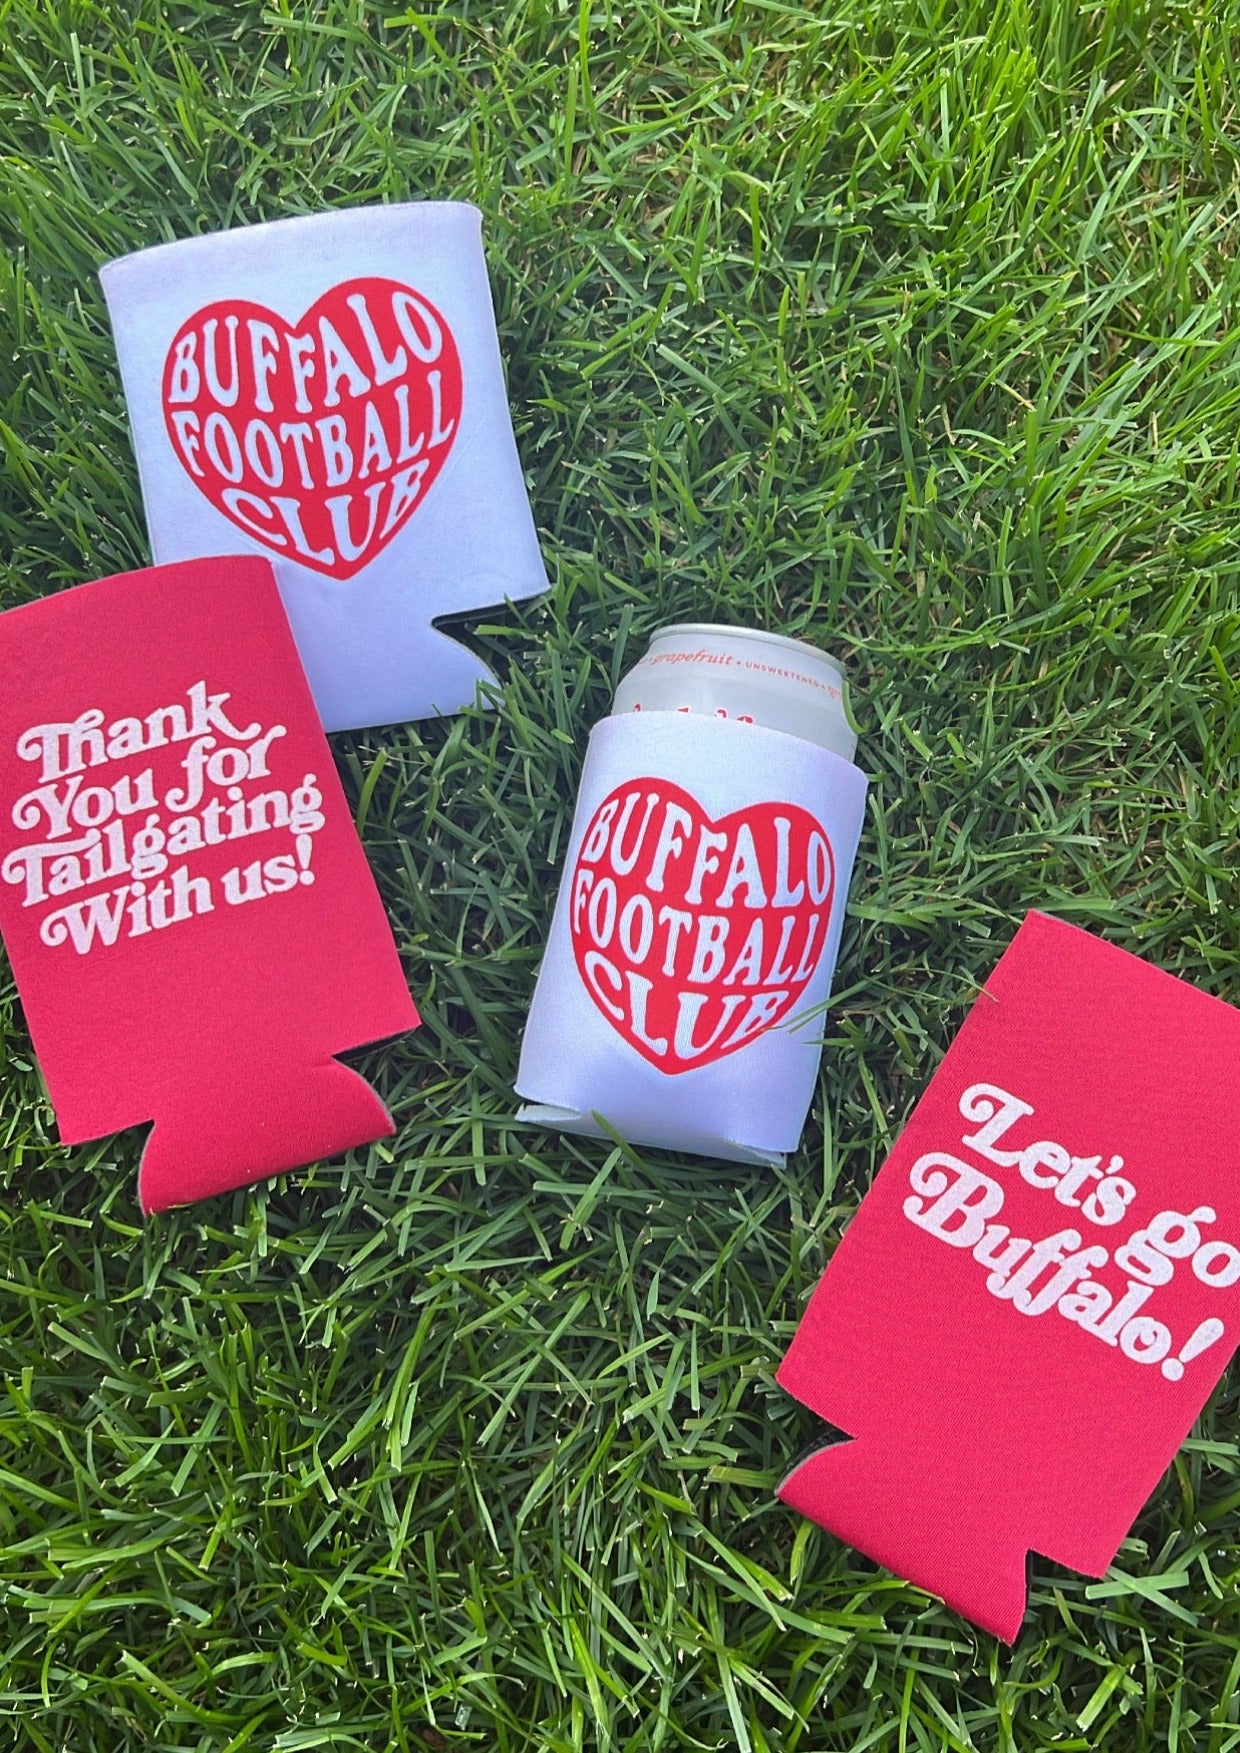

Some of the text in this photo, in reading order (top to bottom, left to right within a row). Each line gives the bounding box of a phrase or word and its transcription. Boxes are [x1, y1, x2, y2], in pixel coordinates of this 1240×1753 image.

[168, 291, 443, 414] BUFFALO
[171, 370, 454, 489] FOOTBALL
[221, 459, 430, 566] CLUB
[650, 649, 733, 665] grapefruit
[745, 661, 820, 688] UNSWEETENED
[12, 725, 287, 840] You for
[16, 680, 262, 784] Thank
[1, 773, 326, 908] Tailgating
[40, 834, 316, 955] With us!
[581, 792, 831, 909] BUFFALO
[574, 868, 819, 986] FOOTBALL
[584, 951, 790, 1060] CLUB
[959, 1083, 1240, 1288] Let's go
[903, 1152, 1225, 1381] Buffalo!
